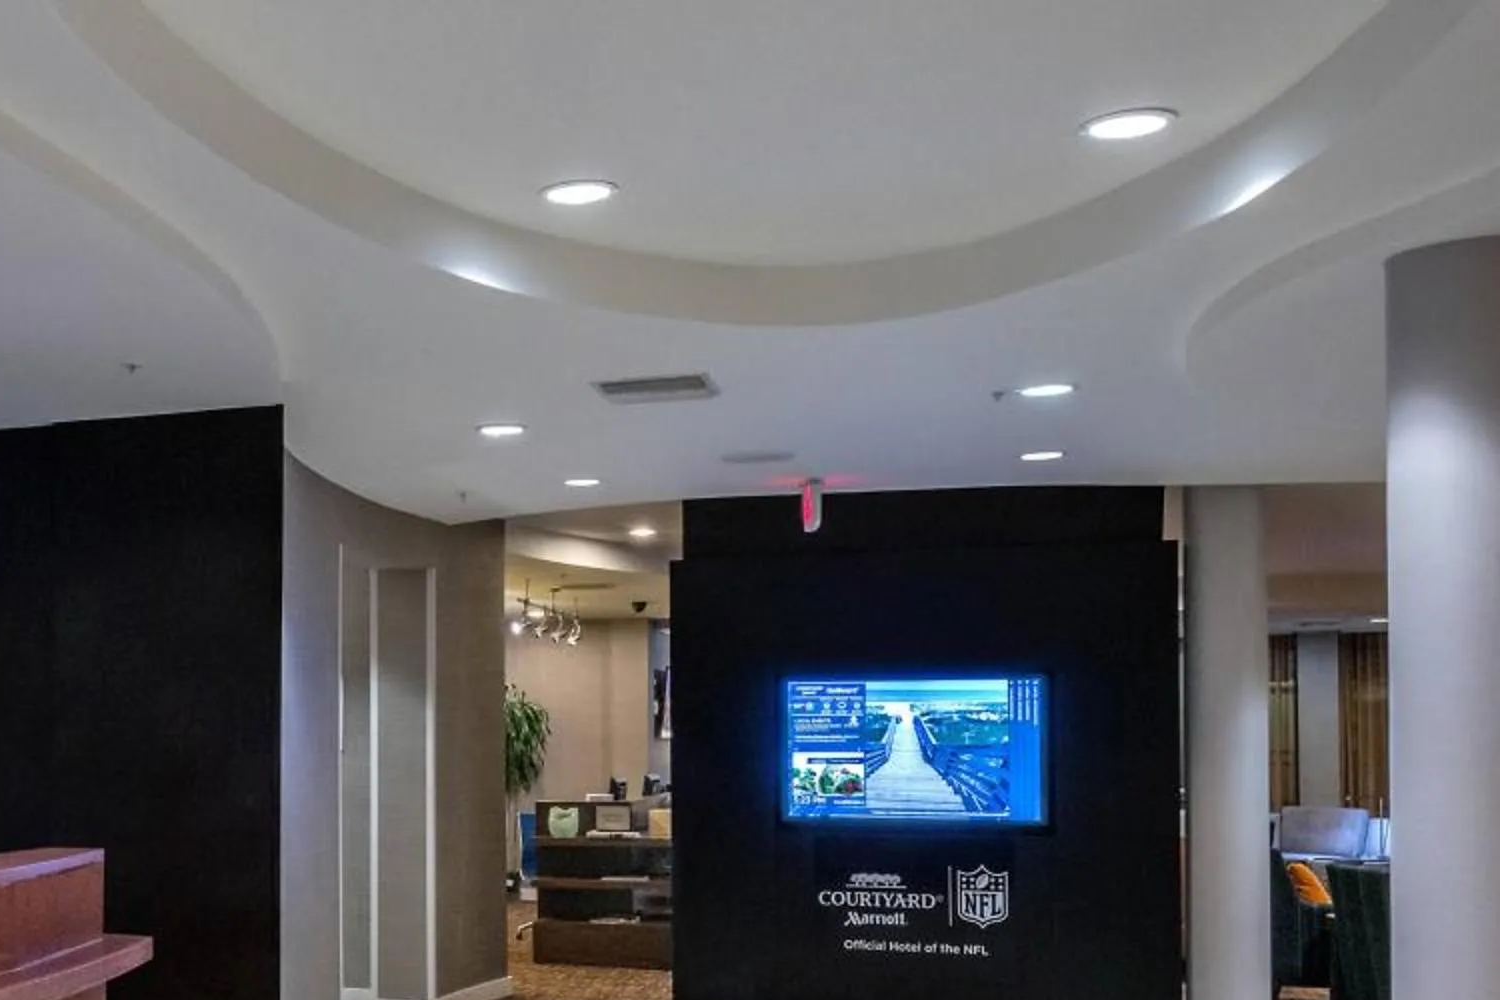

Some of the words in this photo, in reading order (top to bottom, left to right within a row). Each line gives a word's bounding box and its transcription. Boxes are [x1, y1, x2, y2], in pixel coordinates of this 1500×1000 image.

[818, 891, 936, 909] COURTYARD
[961, 891, 1004, 918] NFL
[843, 911, 905, 926] Marriott
[843, 939, 886, 951] Official
[889, 941, 920, 953] Hotel
[923, 942, 937, 953] of
[940, 943, 960, 954] the
[963, 944, 989, 957] NFL
